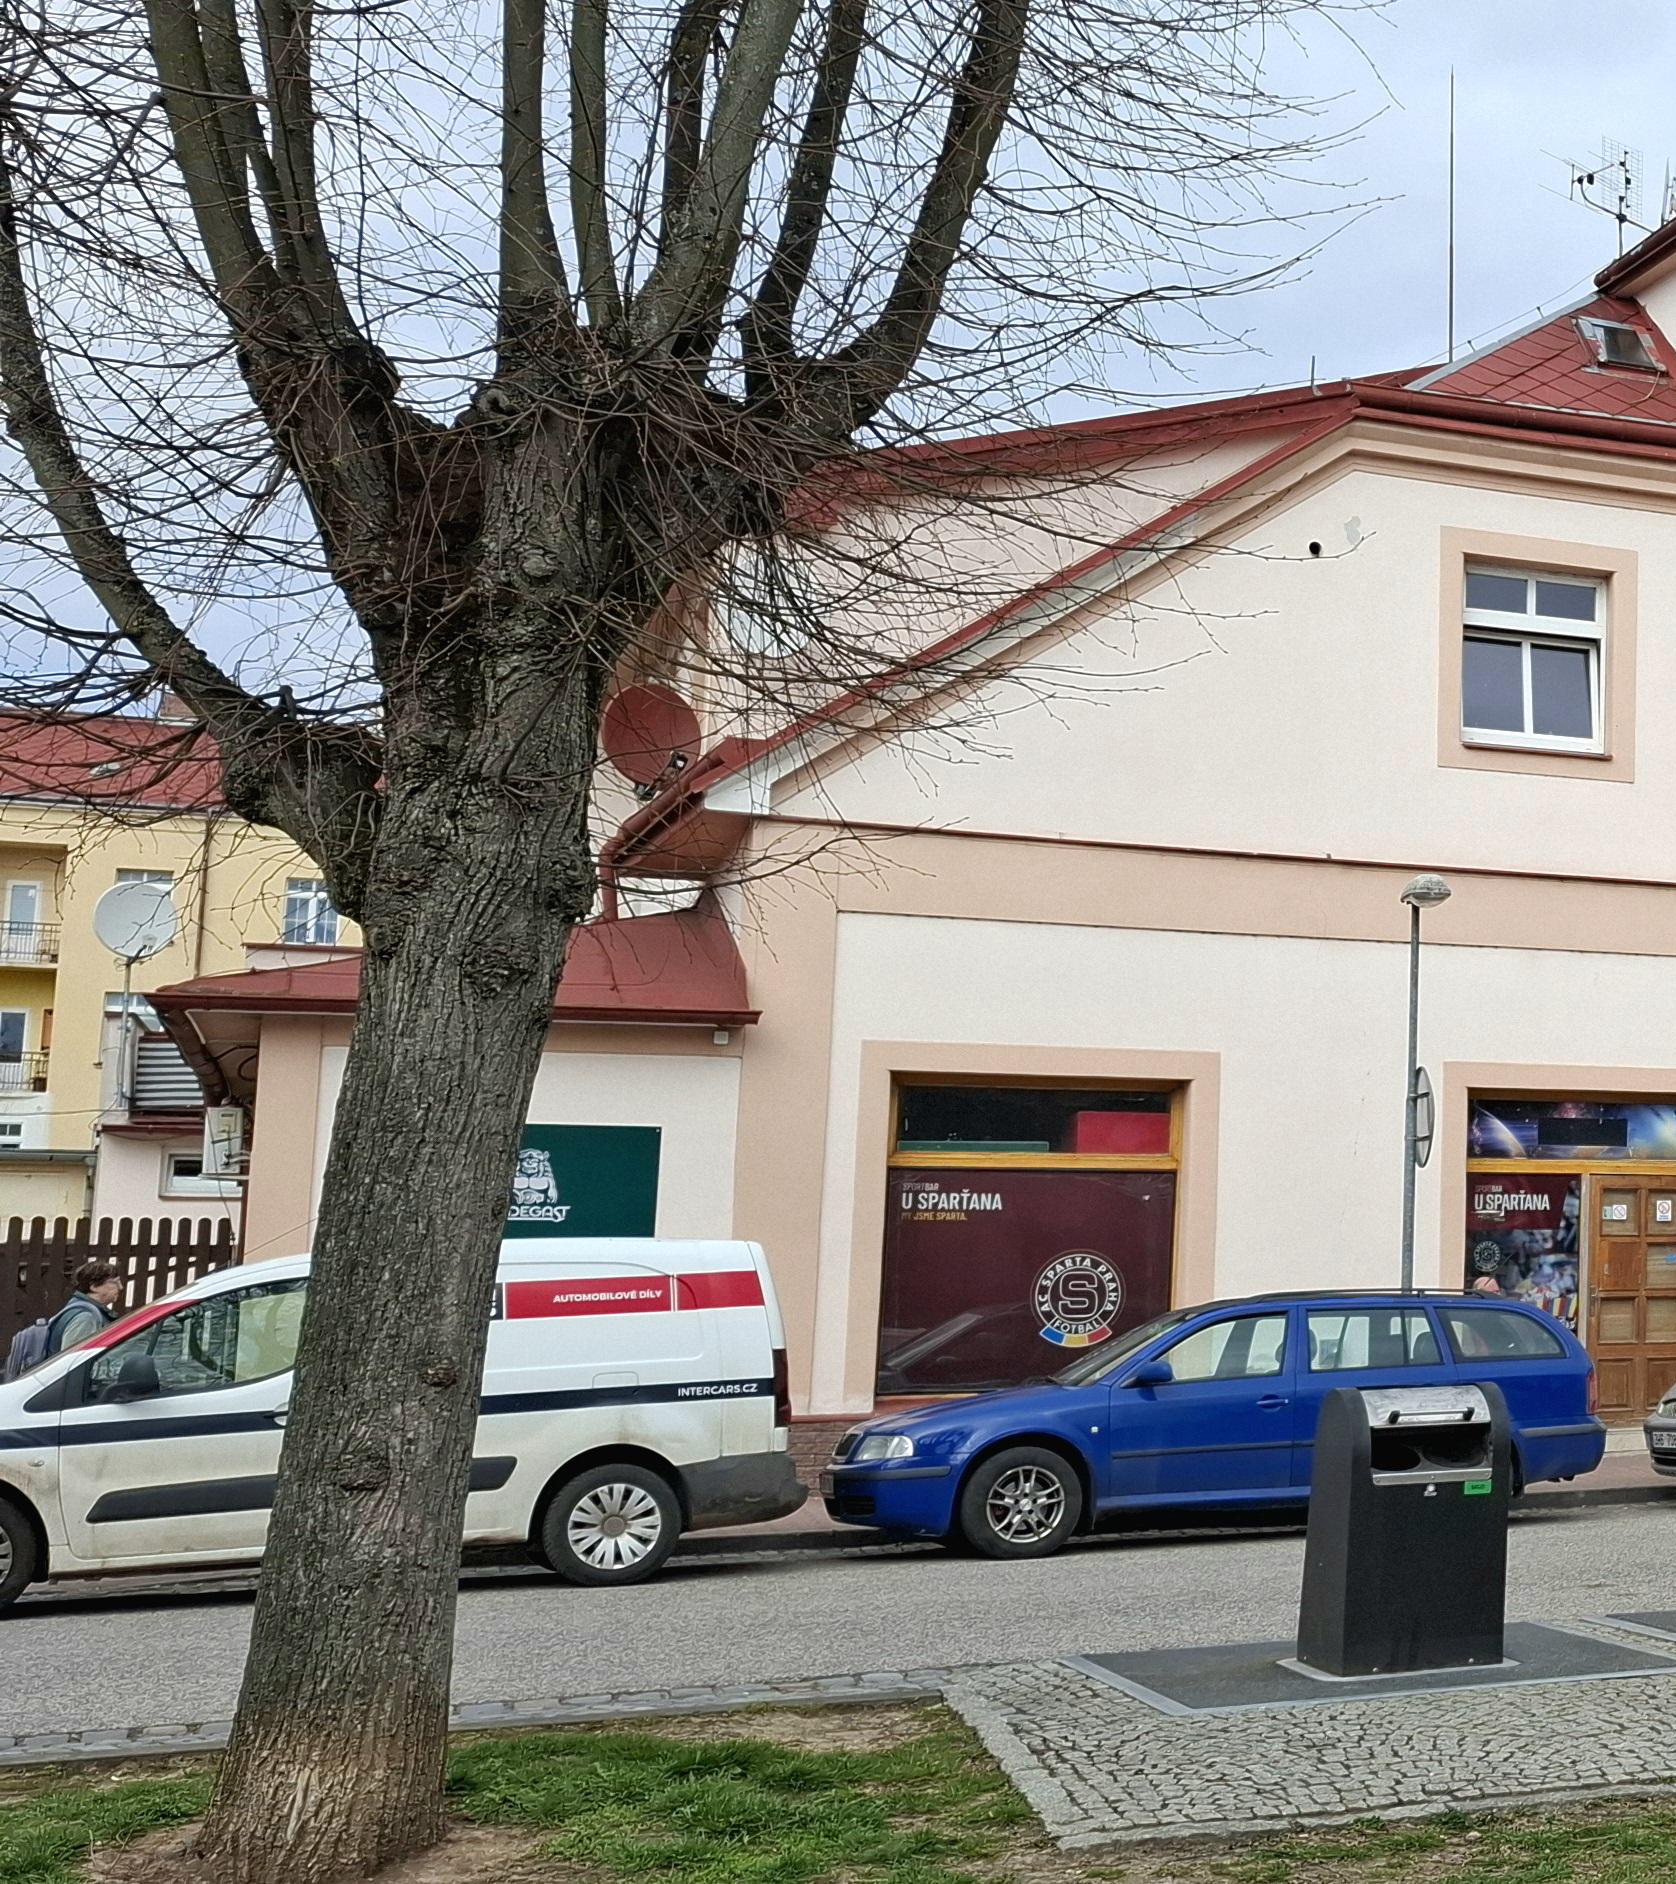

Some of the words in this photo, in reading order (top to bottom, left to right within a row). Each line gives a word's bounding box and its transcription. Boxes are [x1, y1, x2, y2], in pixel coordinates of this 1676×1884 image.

[902, 1193, 913, 1210] U
[917, 1189, 1003, 1211] SPARŤANA
[1474, 1194, 1483, 1210] U
[1486, 1190, 1550, 1210] SPARŤANA
[508, 1206, 571, 1222] DEGAST
[1041, 1257, 1091, 1287] SPARTA
[553, 1290, 637, 1303] AUTOMOBILOVÉ
[639, 1289, 662, 1299] DÍLY
[1059, 1271, 1098, 1318] S
[1096, 1264, 1118, 1311] PRAHA
[1039, 1294, 1051, 1311] AC
[1053, 1320, 1100, 1335] FOTBAL
[678, 1383, 758, 1397] INTERCARS.CZ
